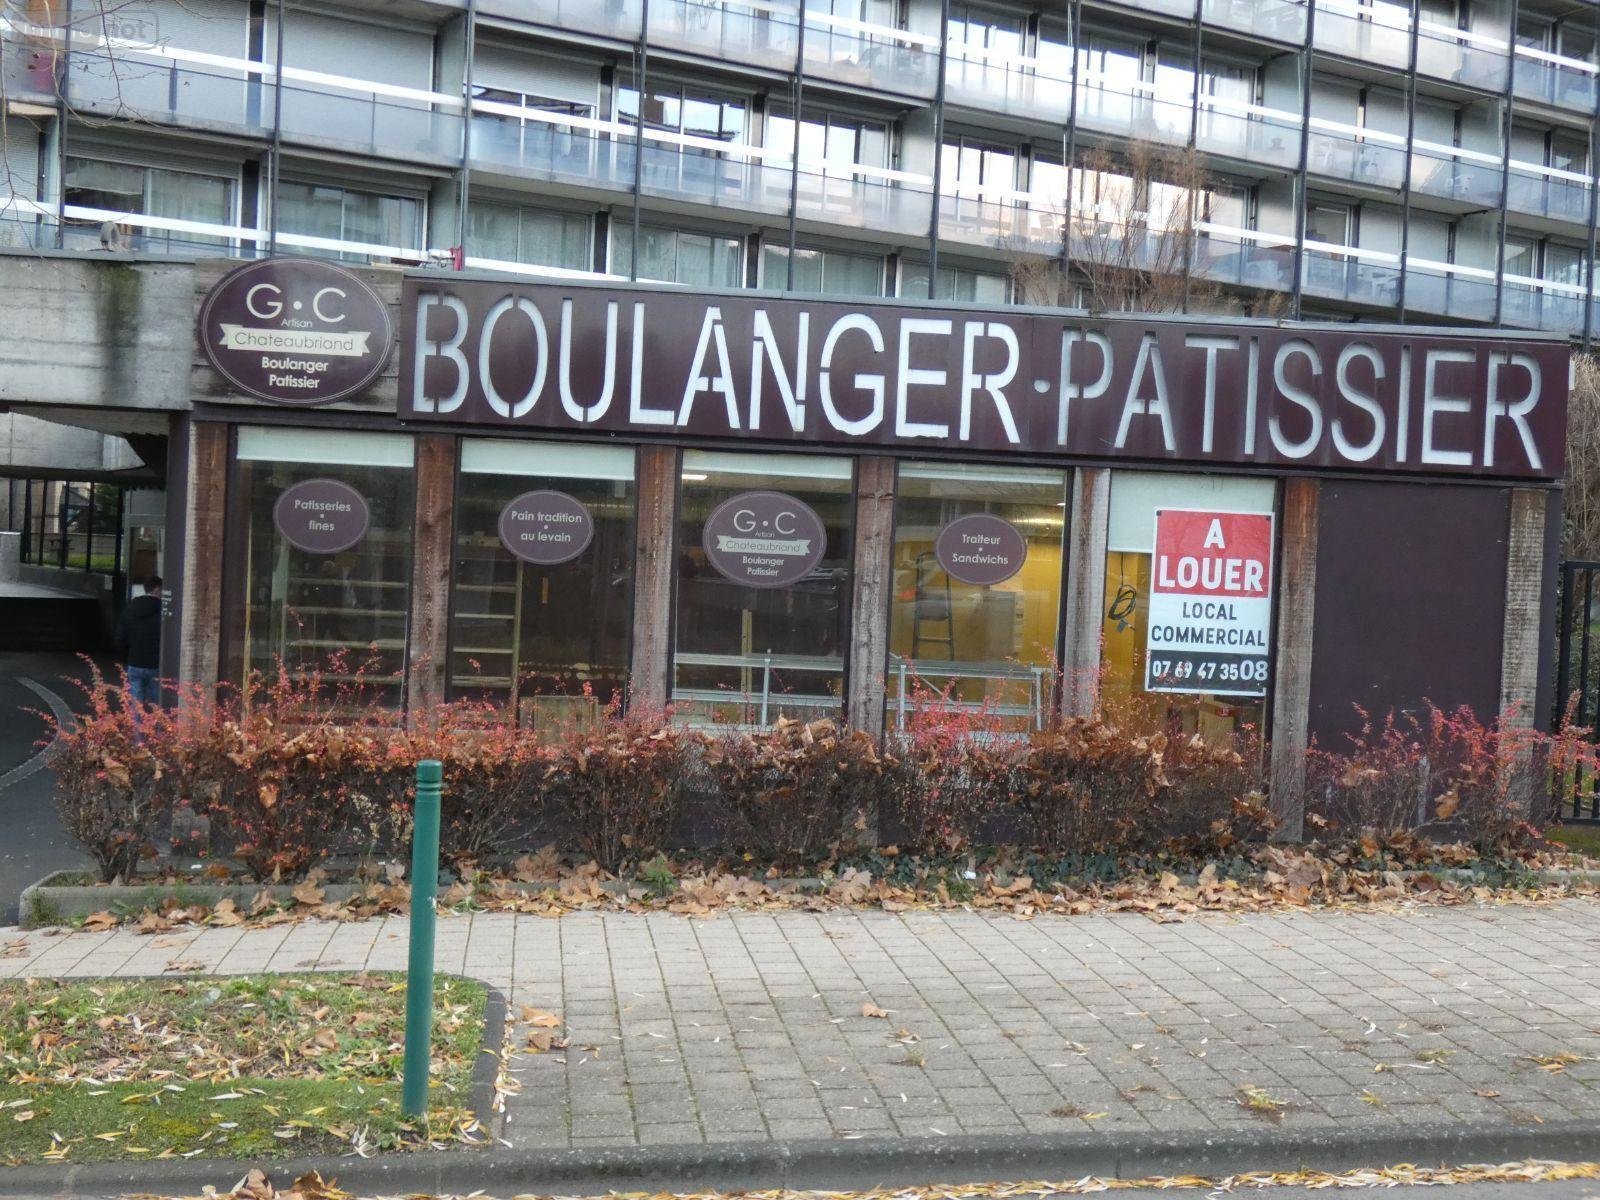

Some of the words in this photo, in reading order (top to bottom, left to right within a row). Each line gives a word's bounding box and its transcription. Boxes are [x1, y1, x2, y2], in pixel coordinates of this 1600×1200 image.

[280, 317, 313, 328] Artisan
[234, 331, 354, 351] Chateaubriand
[261, 356, 329, 374] Boulanger
[269, 374, 320, 389] Patissier
[411, 293, 1022, 445] BOULANGER
[1056, 325, 1543, 471] PATISSIER
[294, 499, 351, 513] Patisseries
[511, 510, 535, 521] Pain
[537, 512, 582, 523] tradition
[308, 520, 335, 532] fines
[520, 532, 535, 541] au
[538, 531, 571, 543] levain
[962, 534, 1001, 545] Traiteur
[1203, 518, 1226, 550] A
[725, 540, 801, 553] Chateaubriand
[742, 555, 785, 567] Boulanger
[952, 552, 1009, 565] Sandwichs
[747, 567, 779, 577] Patissier
[1158, 555, 1264, 593] LOUER
[1182, 601, 1238, 620] LOCAL
[1151, 625, 1266, 647] COMMERCIAL
[1152, 660, 1171, 678] 07
[1197, 662, 1217, 680] 47
